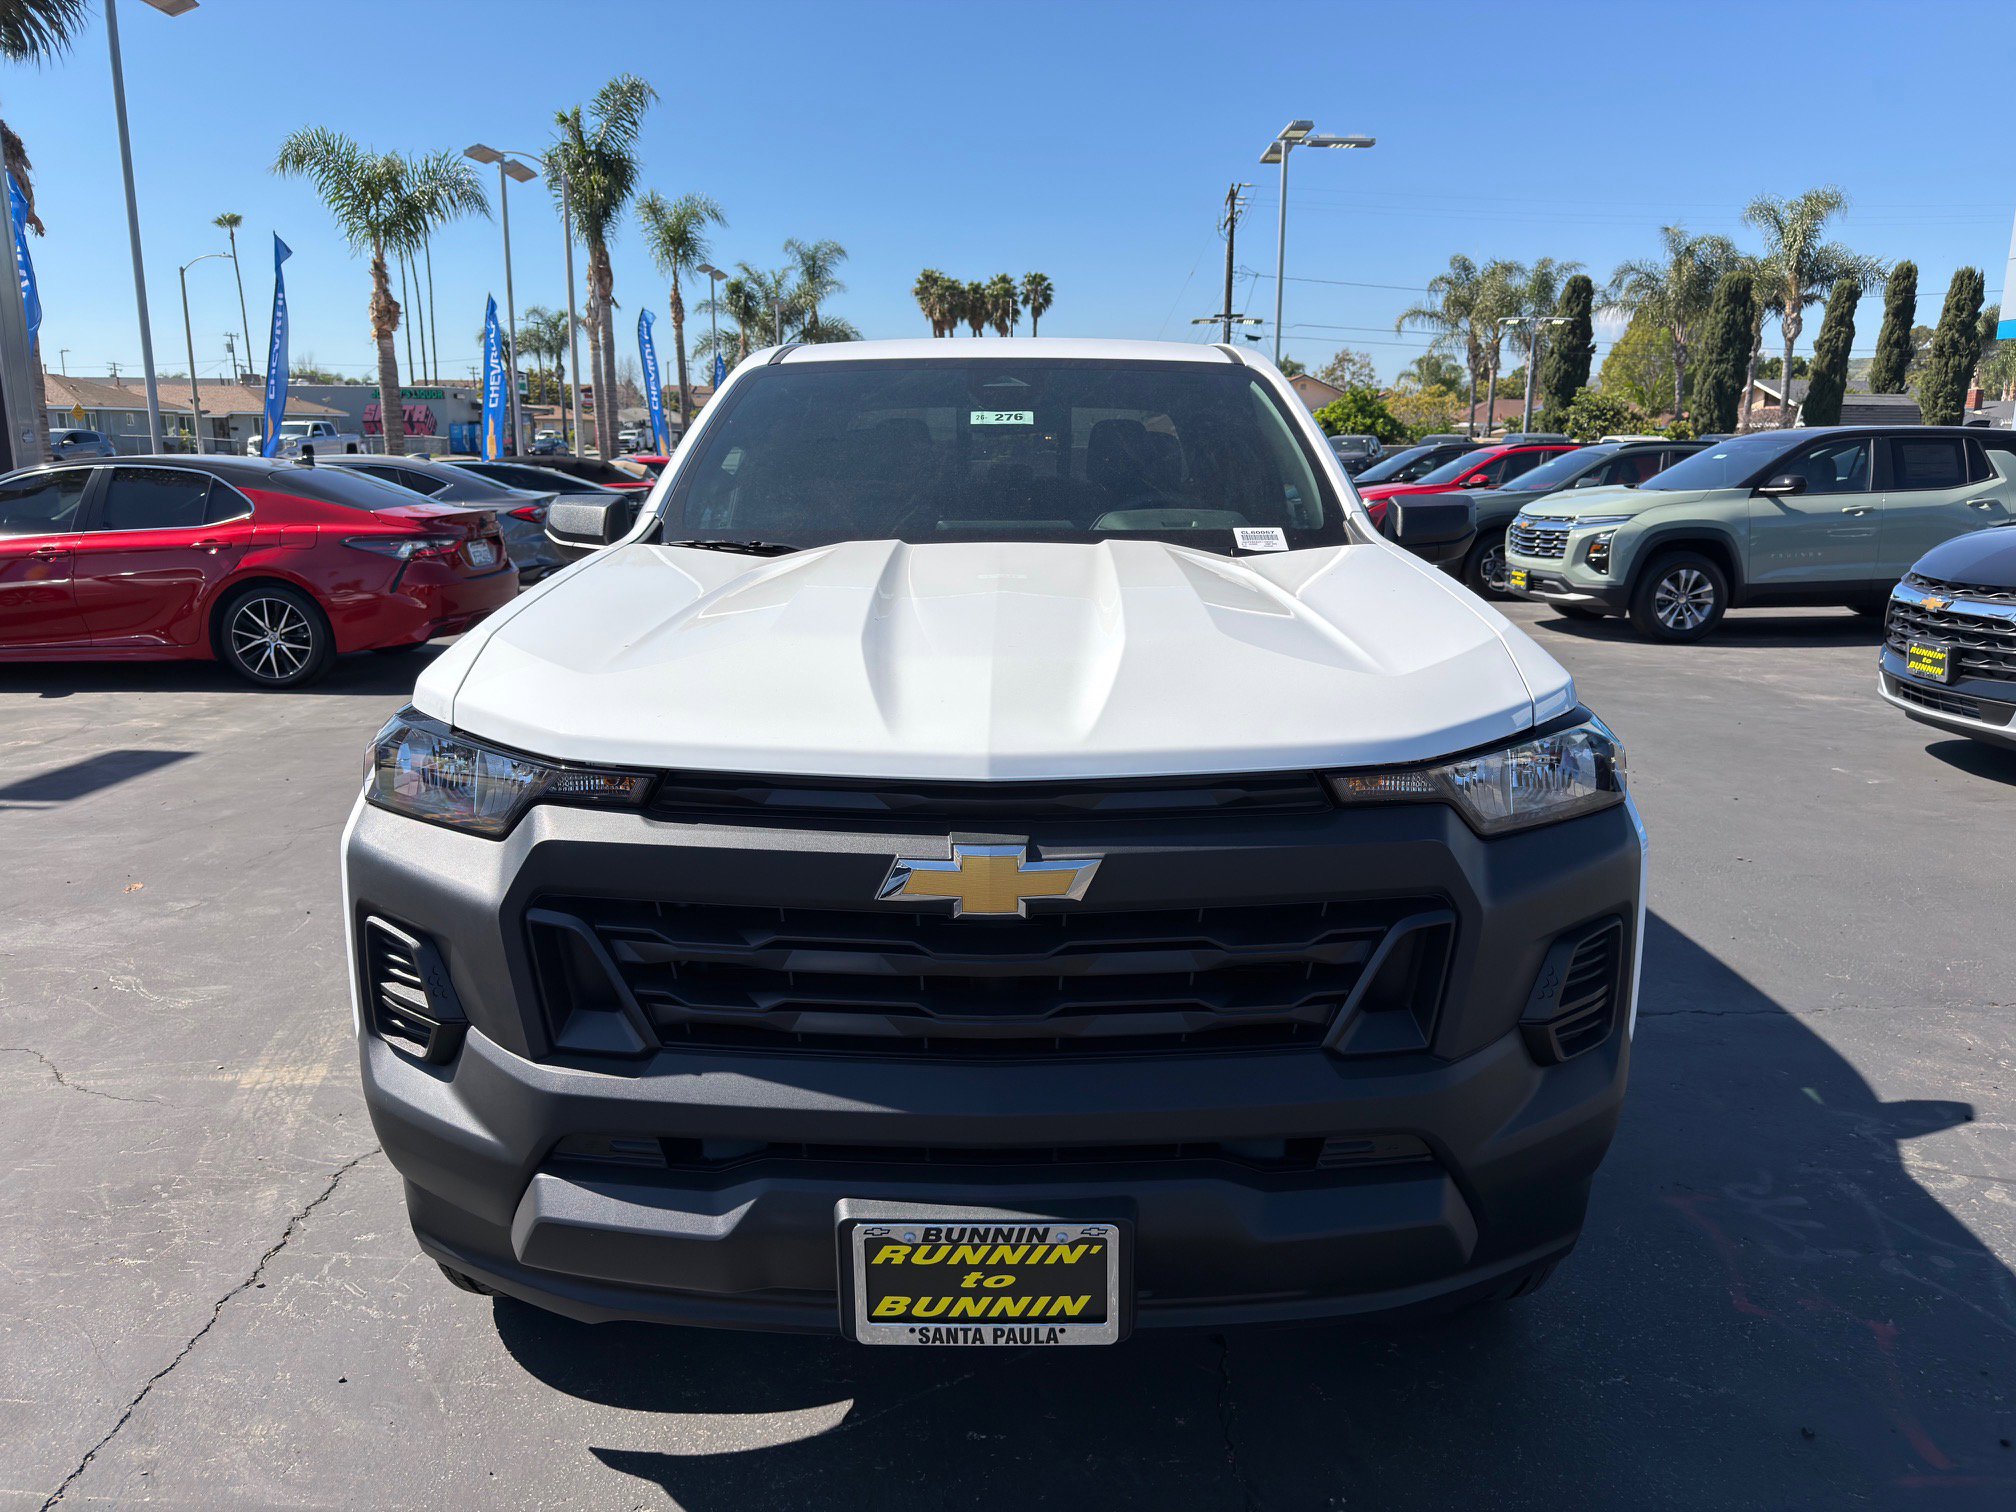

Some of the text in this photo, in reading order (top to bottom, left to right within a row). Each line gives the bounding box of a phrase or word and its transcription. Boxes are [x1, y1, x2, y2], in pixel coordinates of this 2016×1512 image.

[413, 388, 446, 400] LIQUOR
[362, 404, 429, 422] SATA
[994, 413, 1024, 422] 276
[1910, 646, 1946, 659] RUNNIN'
[1909, 661, 1944, 675] BUNNIN
[921, 1227, 1049, 1243] BUNNIN
[871, 1244, 1103, 1265] RUNNIN'
[960, 1271, 1017, 1289] to
[871, 1294, 1092, 1318] BUNNIN
[918, 1326, 1059, 1345] SANTA PAULA
